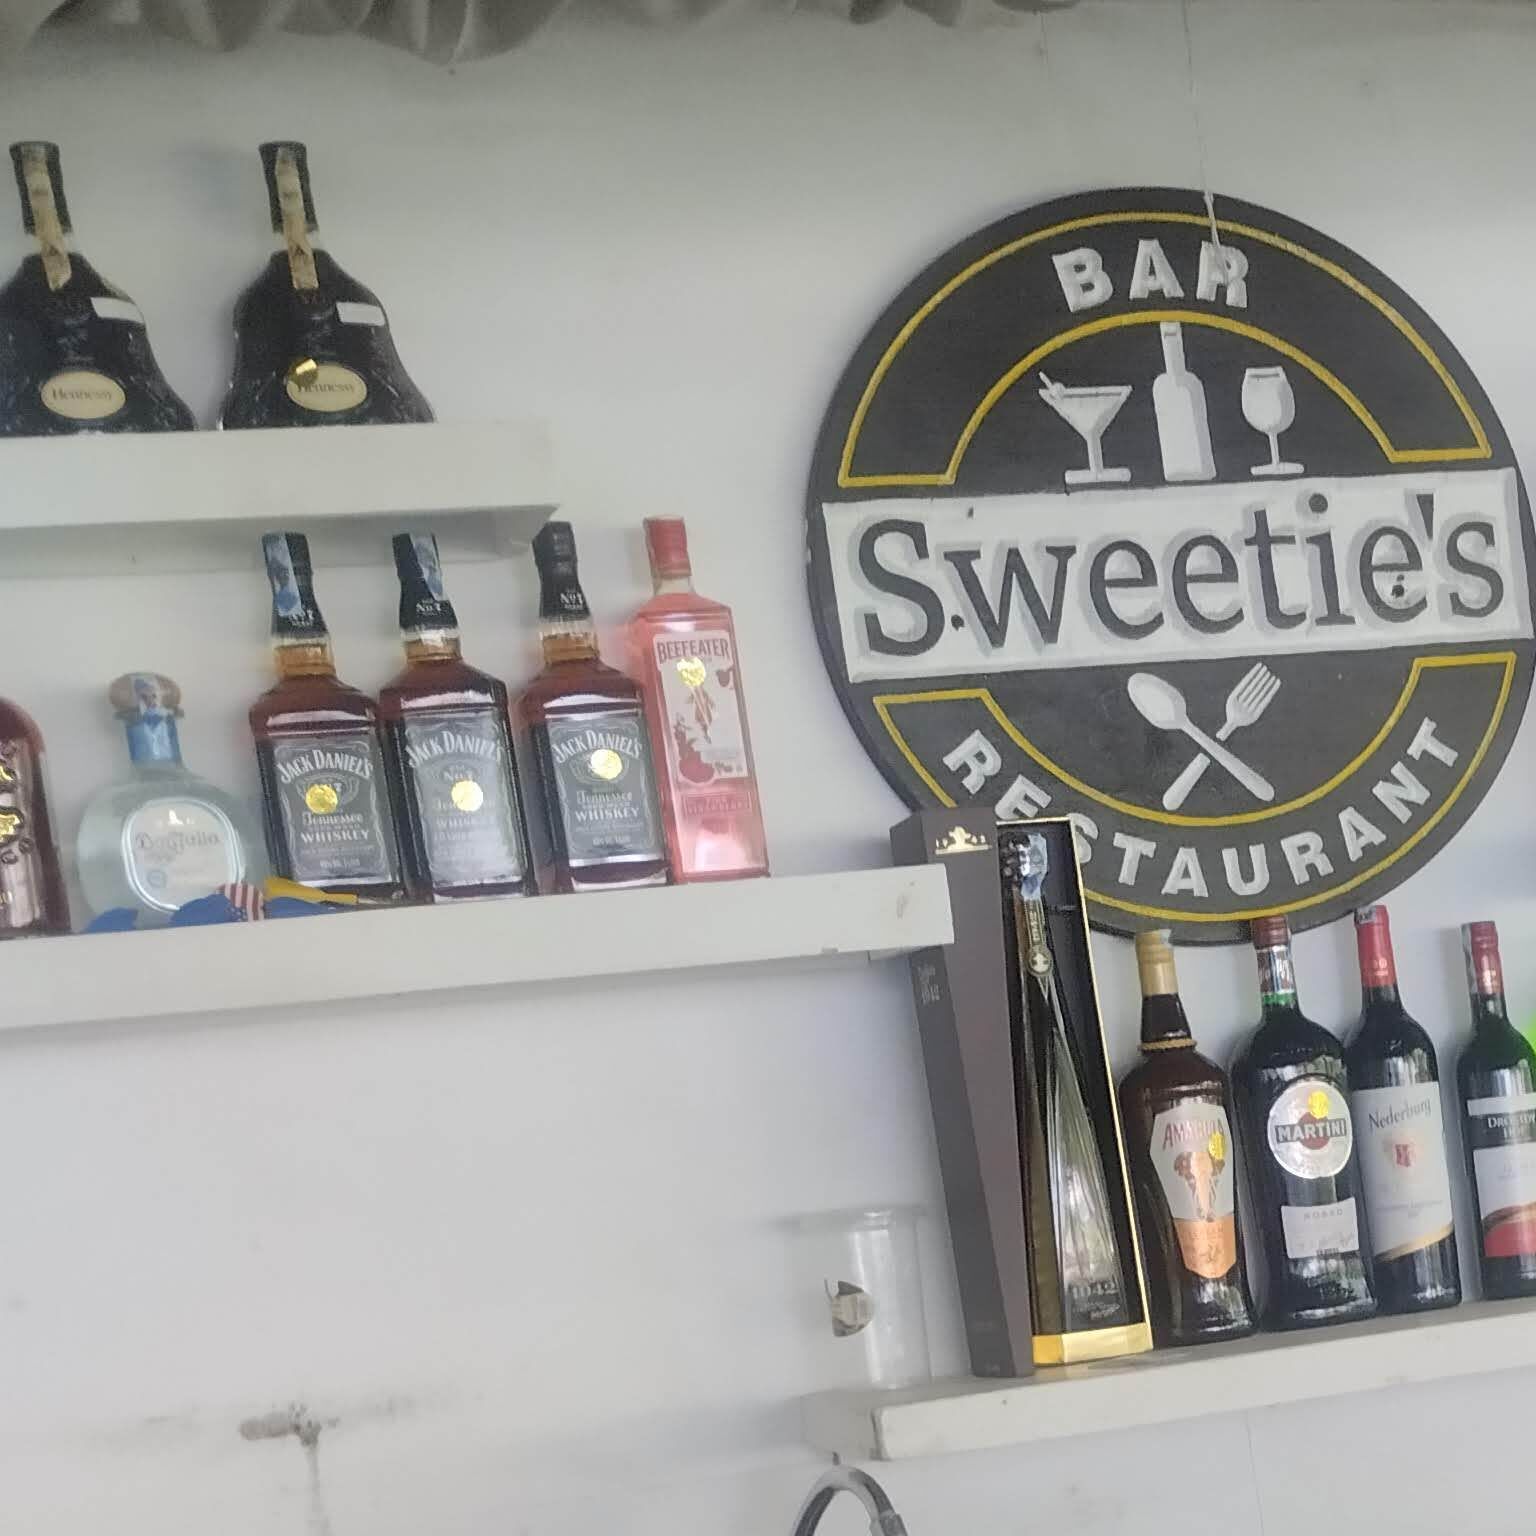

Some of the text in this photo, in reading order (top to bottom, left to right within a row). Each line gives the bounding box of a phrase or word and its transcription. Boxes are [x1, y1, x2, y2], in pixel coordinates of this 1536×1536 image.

[1052, 239, 1251, 312] BAR
[857, 493, 1504, 657] Sweetie's
[656, 637, 730, 665] BEEFEATER
[406, 735, 443, 769] JACK
[551, 735, 588, 764] JACK
[276, 753, 315, 784] JACK
[574, 806, 640, 822] WHISKEY
[942, 717, 1460, 898] RESTAURANT
[300, 828, 370, 844] WHISKEY
[1368, 1097, 1432, 1130] Nederburg
[1276, 1118, 1347, 1143] MARTINI
